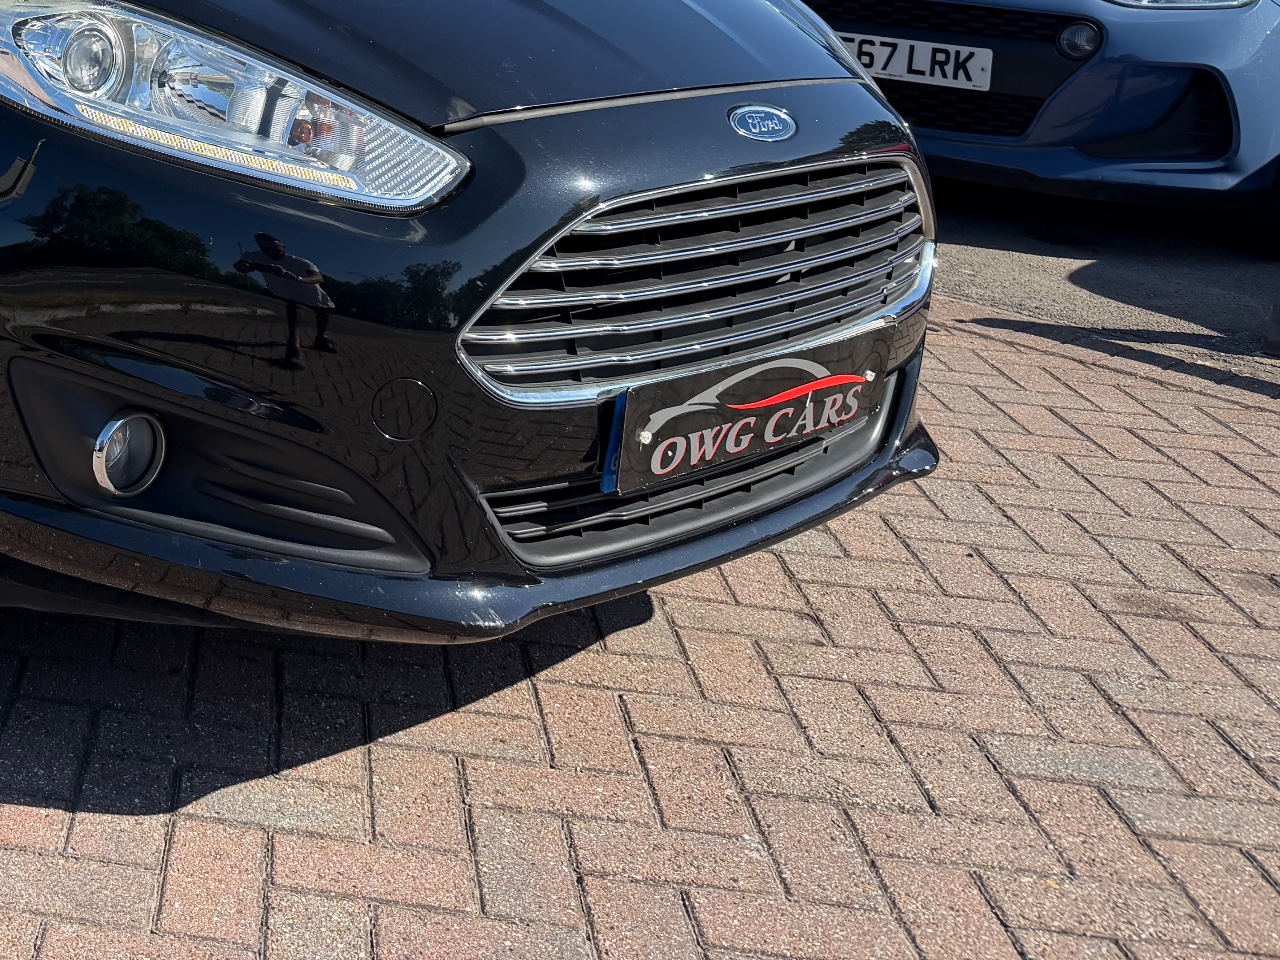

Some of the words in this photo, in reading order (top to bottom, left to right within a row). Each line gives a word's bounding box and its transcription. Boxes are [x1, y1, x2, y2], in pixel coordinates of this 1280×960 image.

[839, 36, 898, 71] 67
[906, 44, 975, 83] LRK
[745, 112, 783, 133] Ford
[650, 416, 757, 476] OWG
[764, 384, 863, 444] CARS
